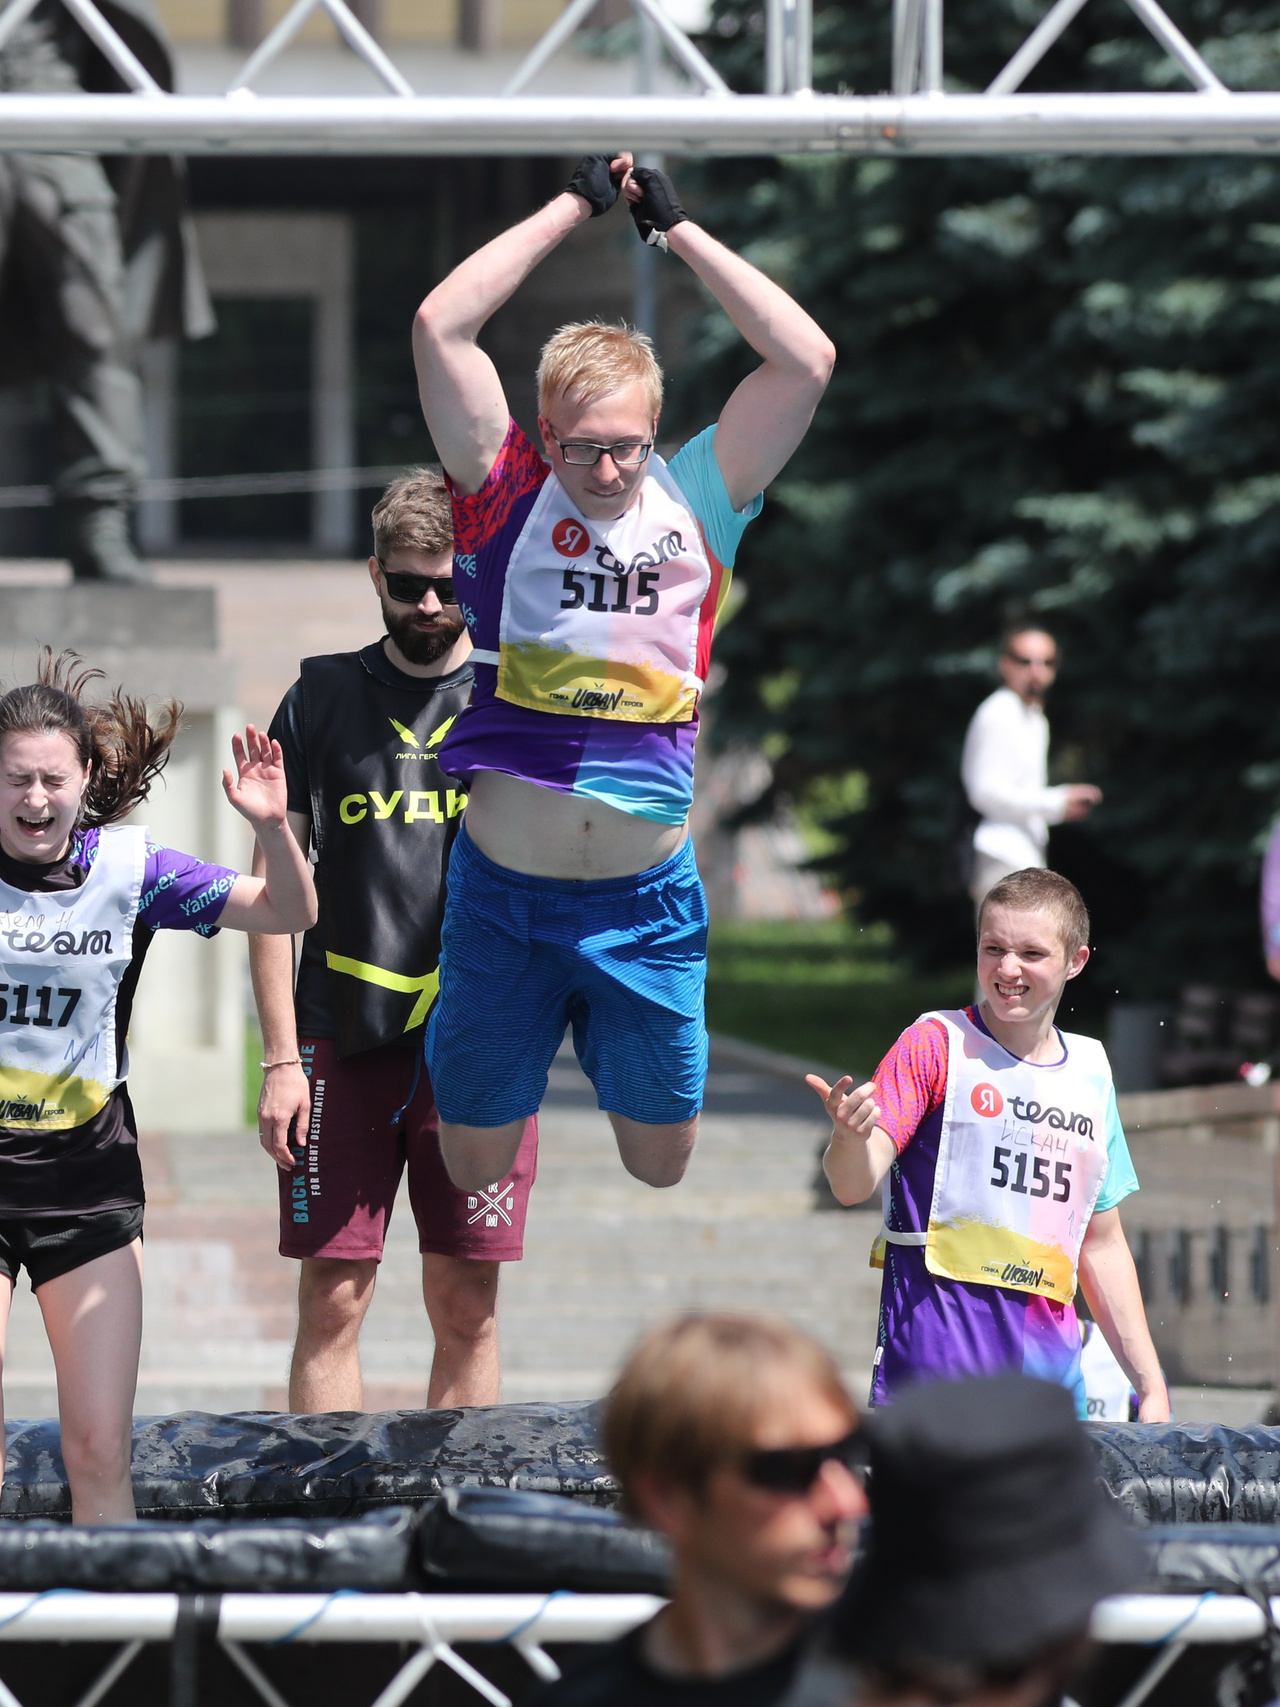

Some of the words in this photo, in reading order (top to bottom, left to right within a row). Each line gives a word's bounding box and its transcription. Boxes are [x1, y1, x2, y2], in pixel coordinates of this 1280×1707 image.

[560, 569, 660, 616] 5115
[572, 688, 624, 711] URBAN
[339, 789, 469, 825] СУДЬ
[179, 874, 237, 917] Yandex
[2, 930, 113, 955] team
[310, 1079, 326, 1141] DESTINATION
[1007, 1096, 1095, 1142] team
[308, 1144, 319, 1173] RIGHT
[990, 1146, 1072, 1203] 5155
[291, 1175, 309, 1223] BACK
[310, 1177, 322, 1196] FOR
[1001, 1263, 1044, 1288] URBAN
